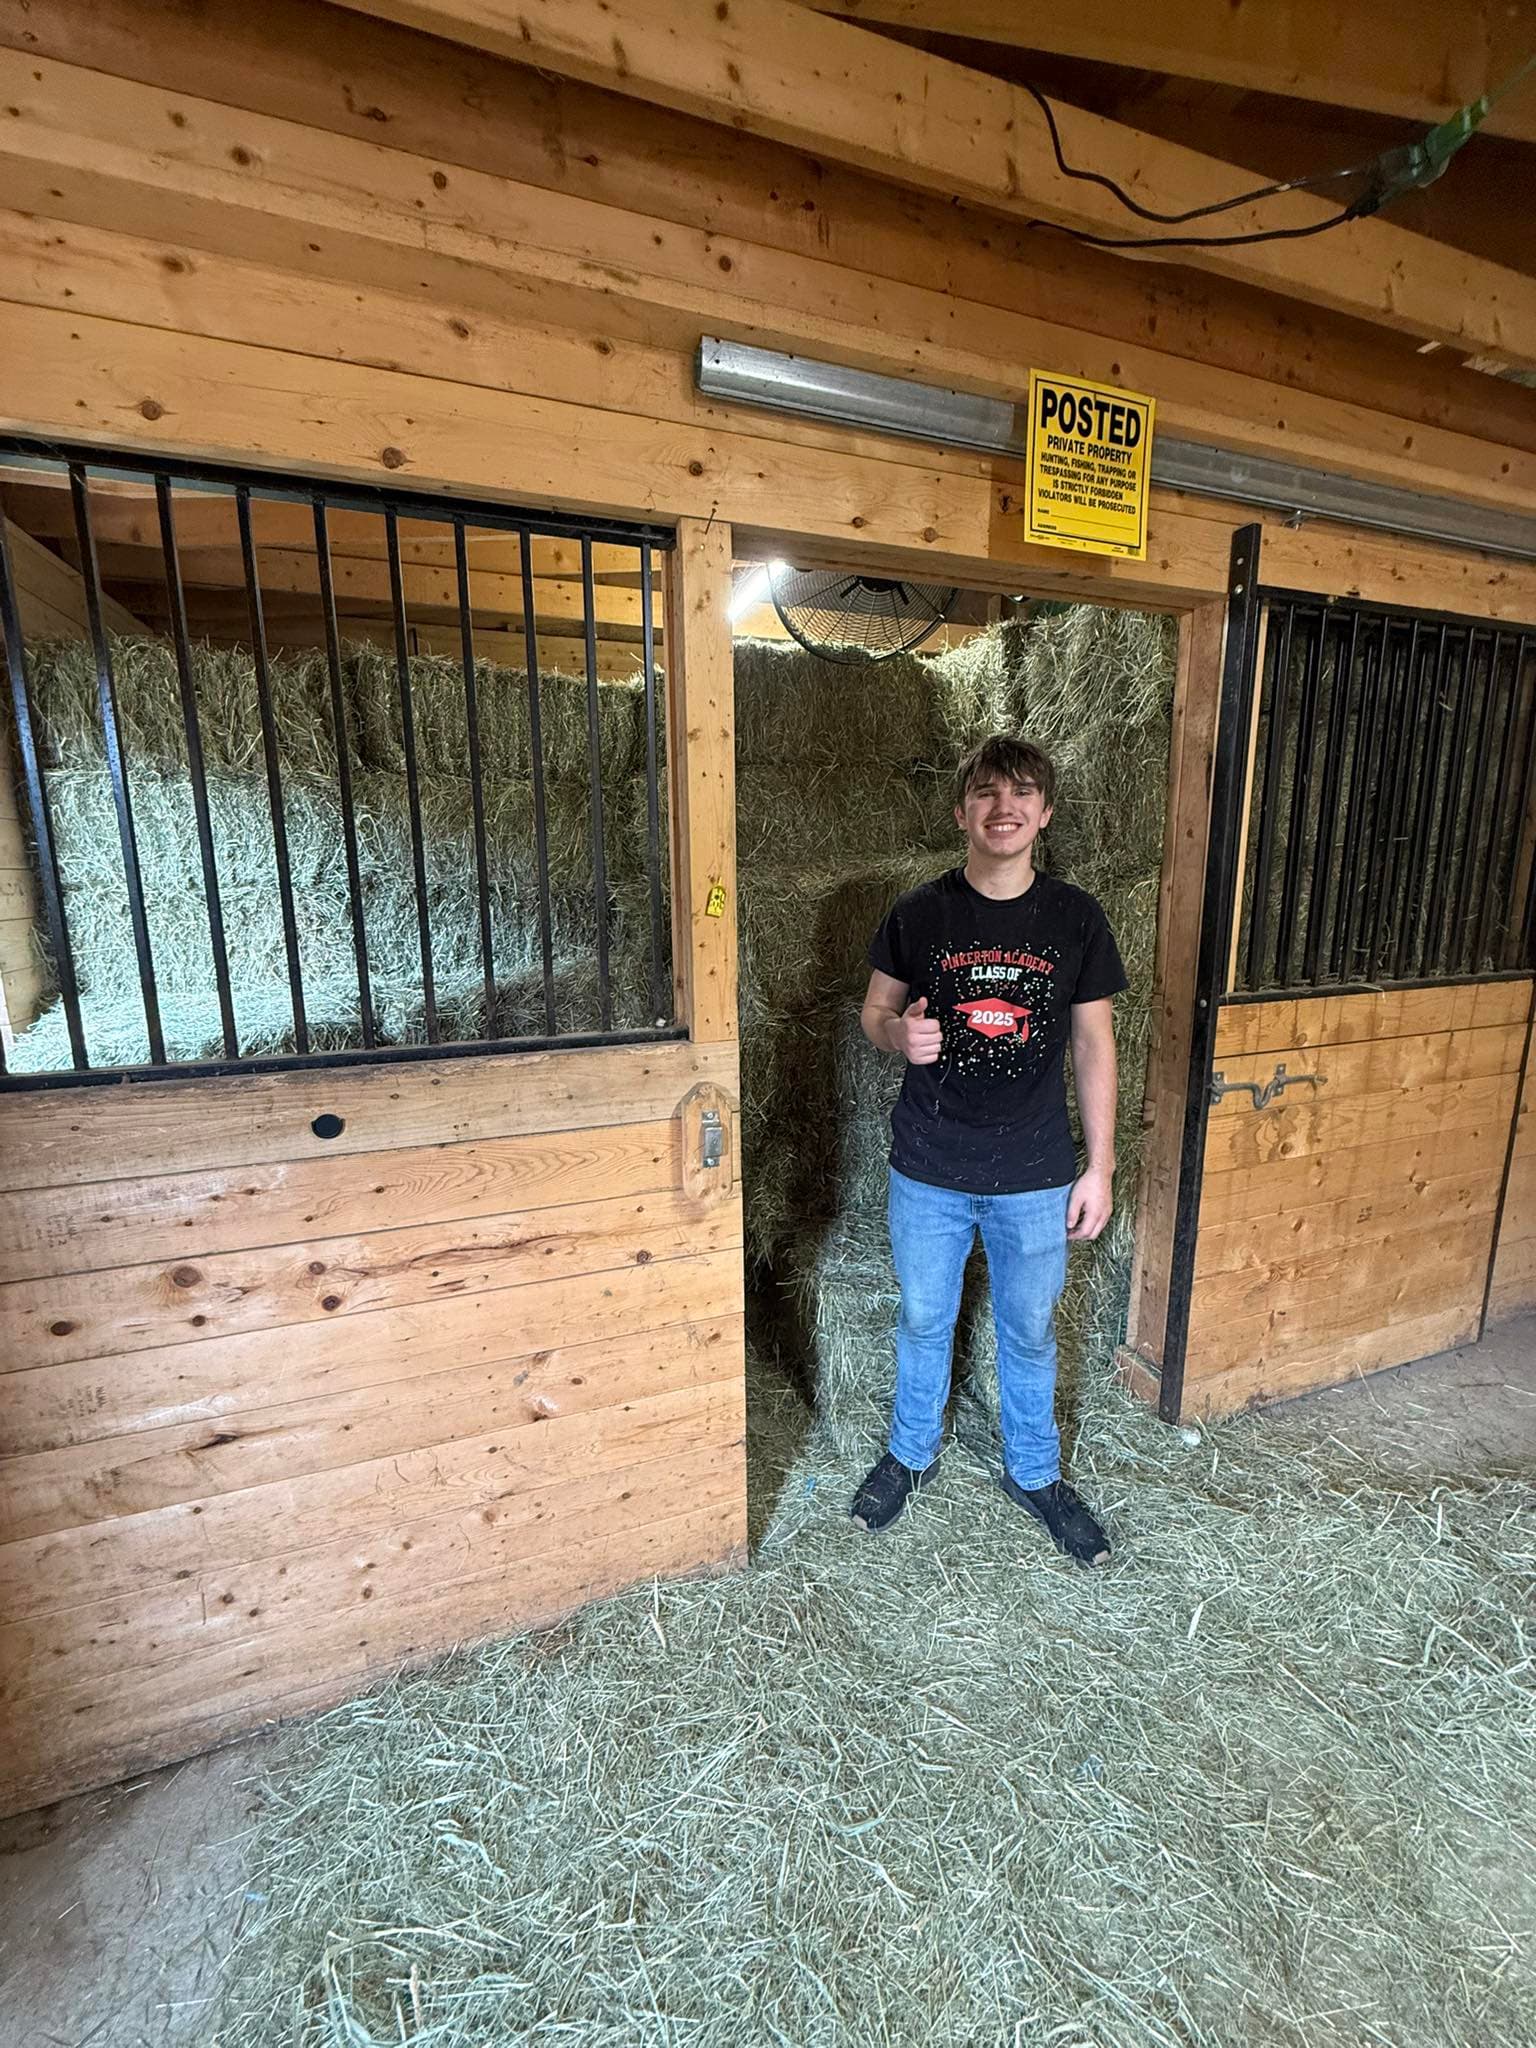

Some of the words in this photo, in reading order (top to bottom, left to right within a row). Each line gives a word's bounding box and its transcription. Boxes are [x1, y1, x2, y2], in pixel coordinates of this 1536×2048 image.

[1041, 388, 1141, 448] POSTED
[1047, 434, 1085, 455] PRIVATE
[1087, 443, 1132, 465] PROPERTY
[1040, 464, 1081, 480] TRESPASSING
[1082, 472, 1095, 482] FOR
[1096, 475, 1109, 486] ANY
[1109, 478, 1136, 491] PURPOSE
[1041, 452, 1070, 468] HUNTING,
[1071, 458, 1096, 473] FISHING,
[1098, 463, 1126, 478] TRAPPING
[1127, 470, 1136, 479] OR
[1038, 488, 1072, 503] VIOLATORS
[1073, 495, 1087, 506] WILL
[1088, 498, 1096, 508] BE
[1097, 500, 1136, 515] PROSECUTED
[1053, 479, 1059, 488] IS
[1060, 480, 1088, 494] STRICTLY
[1090, 486, 1123, 500] FORBIDDEN
[940, 950, 1003, 972] PINKERTON
[1003, 951, 1055, 976] ACADEMY
[970, 966, 1005, 981] CLASS
[1006, 967, 1023, 981] OF
[971, 1009, 1014, 1026] 2025
